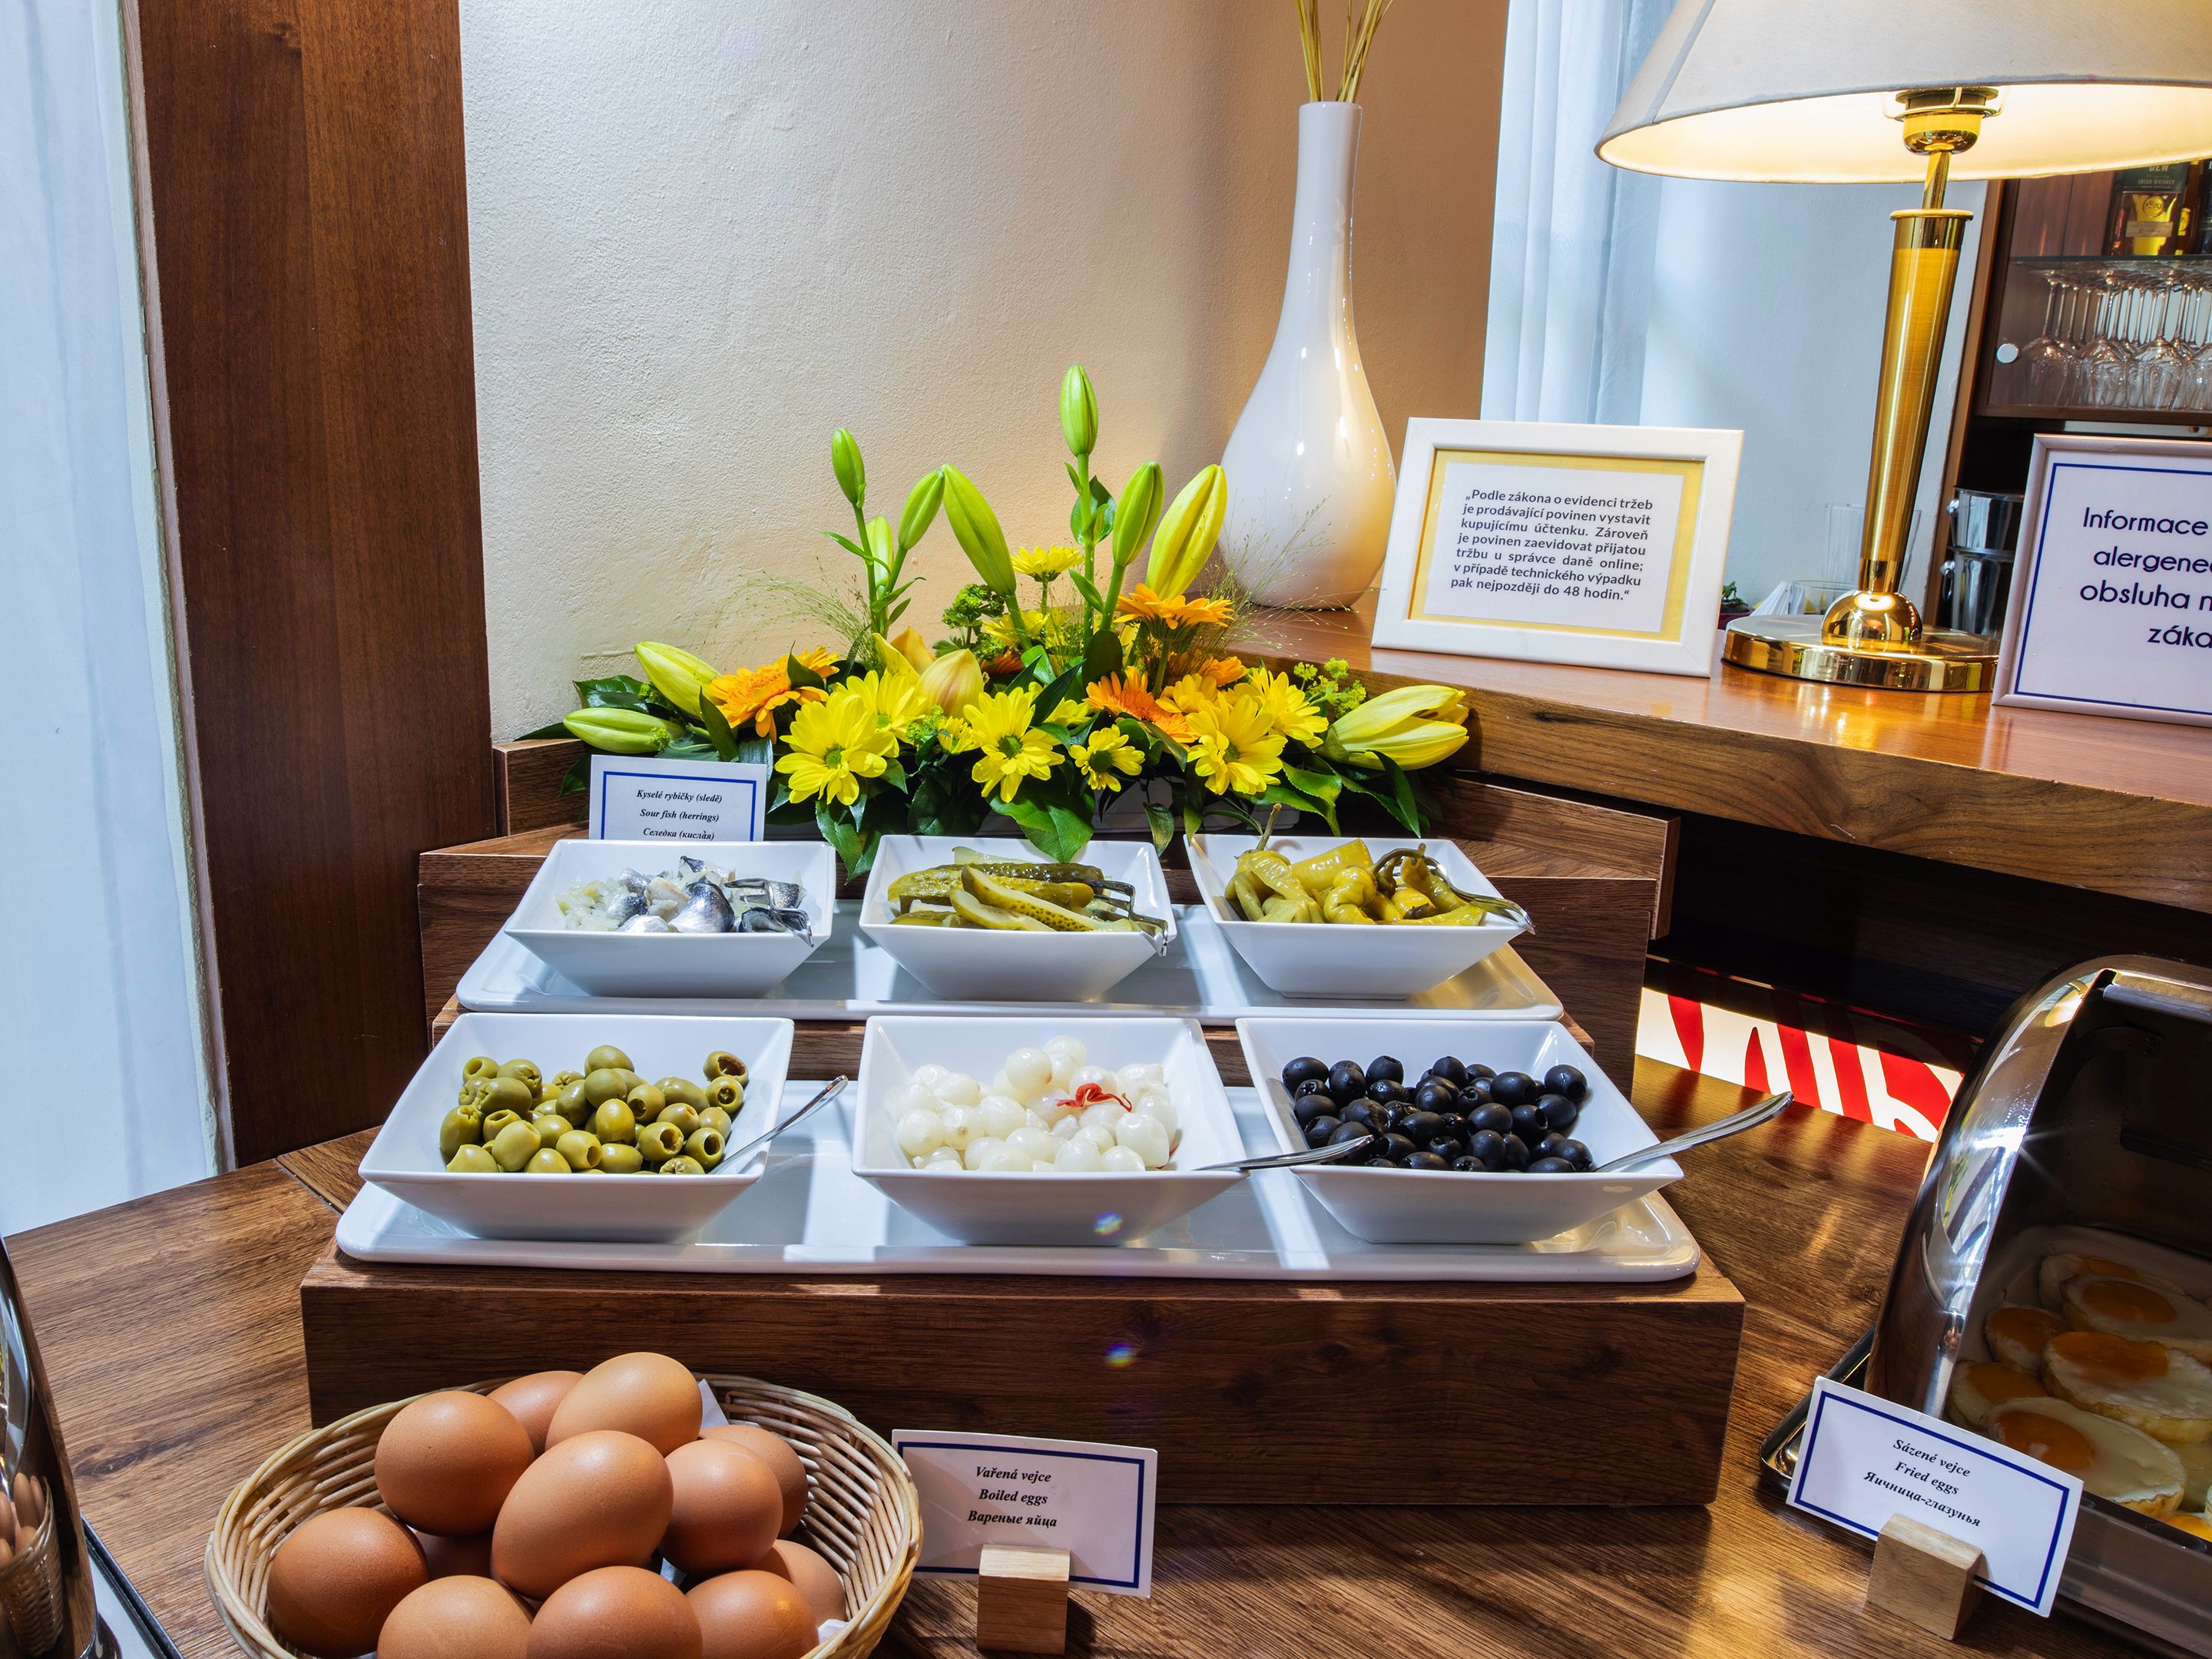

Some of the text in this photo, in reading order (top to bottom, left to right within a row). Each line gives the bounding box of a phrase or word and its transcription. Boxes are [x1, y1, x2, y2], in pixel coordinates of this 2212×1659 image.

[1508, 492, 1551, 503] zákona
[1565, 496, 1617, 507] evidenci
[1620, 499, 1653, 509] tržeb
[1462, 504, 1651, 525] je prodávající povinen vystavit
[2083, 507, 2208, 535] Informace
[1461, 518, 1647, 540] kupujícímu účtenku. Zároveň
[1458, 533, 1645, 555] je povinen zaevidovat přijatou
[1457, 548, 1488, 558] tržbu
[1508, 553, 1555, 564] správce
[1562, 555, 1593, 567] daně
[1600, 559, 1643, 571] online;
[2094, 546, 2212, 573] alergene
[1463, 564, 1508, 575] případě
[1512, 568, 1584, 581] technického
[1588, 573, 1641, 585] výpadku
[1451, 578, 1472, 588] pak
[1477, 580, 1540, 594] nejpozději
[1544, 584, 1559, 594] do
[1564, 586, 1579, 596] 48
[2080, 580, 2190, 609] obsluha
[637, 790, 722, 803] Kyselé rybičky (sledě)
[640, 809, 719, 823] Sour fish (herrings)
[644, 828, 677, 837] Селедка
[1893, 1439, 1970, 1476] Sázené vejce
[977, 1467, 1051, 1484] Vařená vejce
[1895, 1462, 1959, 1494] Fried eggs
[979, 1488, 1048, 1506] Boiled eggs
[1863, 1472, 1980, 1526] Яичница-глазунья
[968, 1511, 1057, 1528] Вареные яйца
